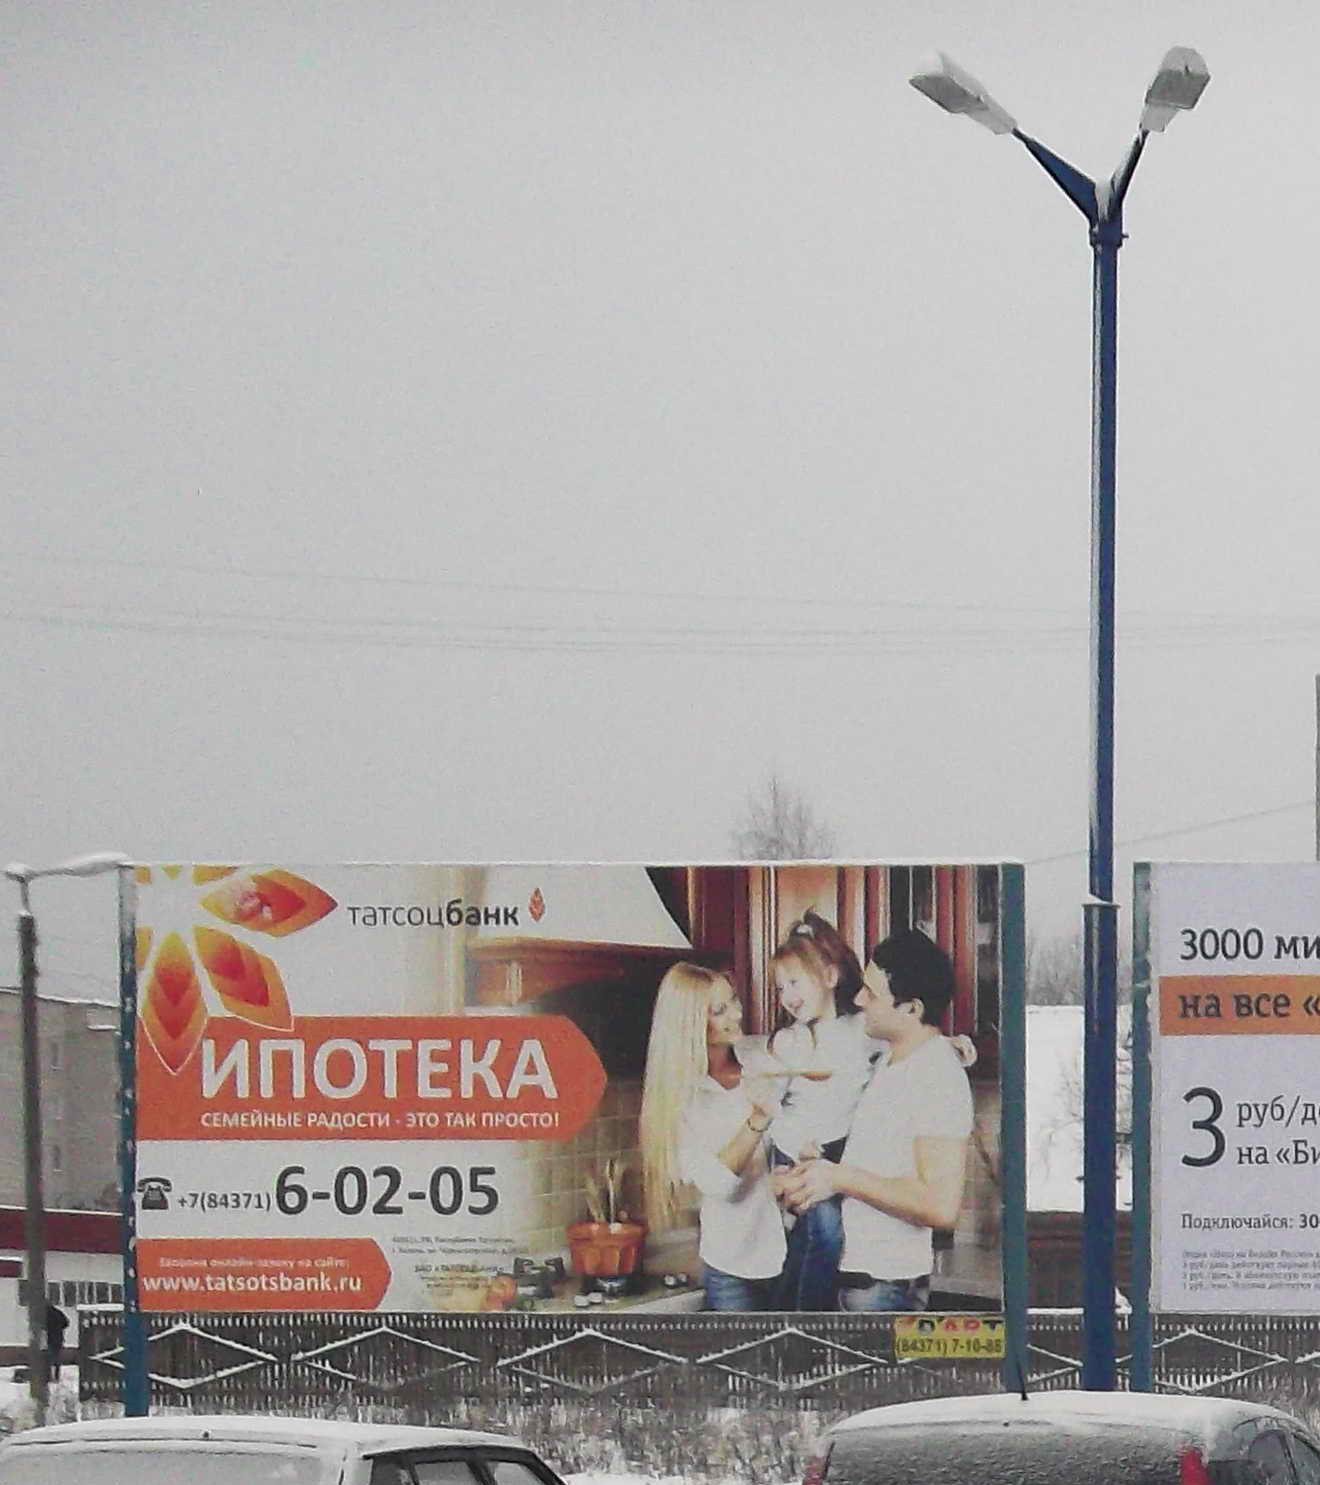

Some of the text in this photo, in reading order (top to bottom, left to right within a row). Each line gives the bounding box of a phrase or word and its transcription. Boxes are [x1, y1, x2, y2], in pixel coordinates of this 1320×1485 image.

[347, 898, 520, 929] татсоцбанк
[1179, 928, 1264, 961] 3000
[1177, 993, 1223, 1019] на
[1233, 993, 1291, 1019] все
[201, 1037, 559, 1100] ИПОТЕКА
[200, 1110, 302, 1128] СЕМЕЙНЫЕ
[306, 1111, 391, 1130] РАДОСТИ
[405, 1111, 440, 1128] ЭТО
[444, 1111, 478, 1128] ТАК
[481, 1111, 560, 1128] ПРОСТО!
[1180, 1086, 1227, 1168] 3
[1236, 1142, 1270, 1166] на
[177, 1165, 499, 1216] +7(84371) 6-02-05
[1180, 1211, 1295, 1232] Подключайся:
[143, 1271, 363, 1292] www.tatsotsbank.ru
